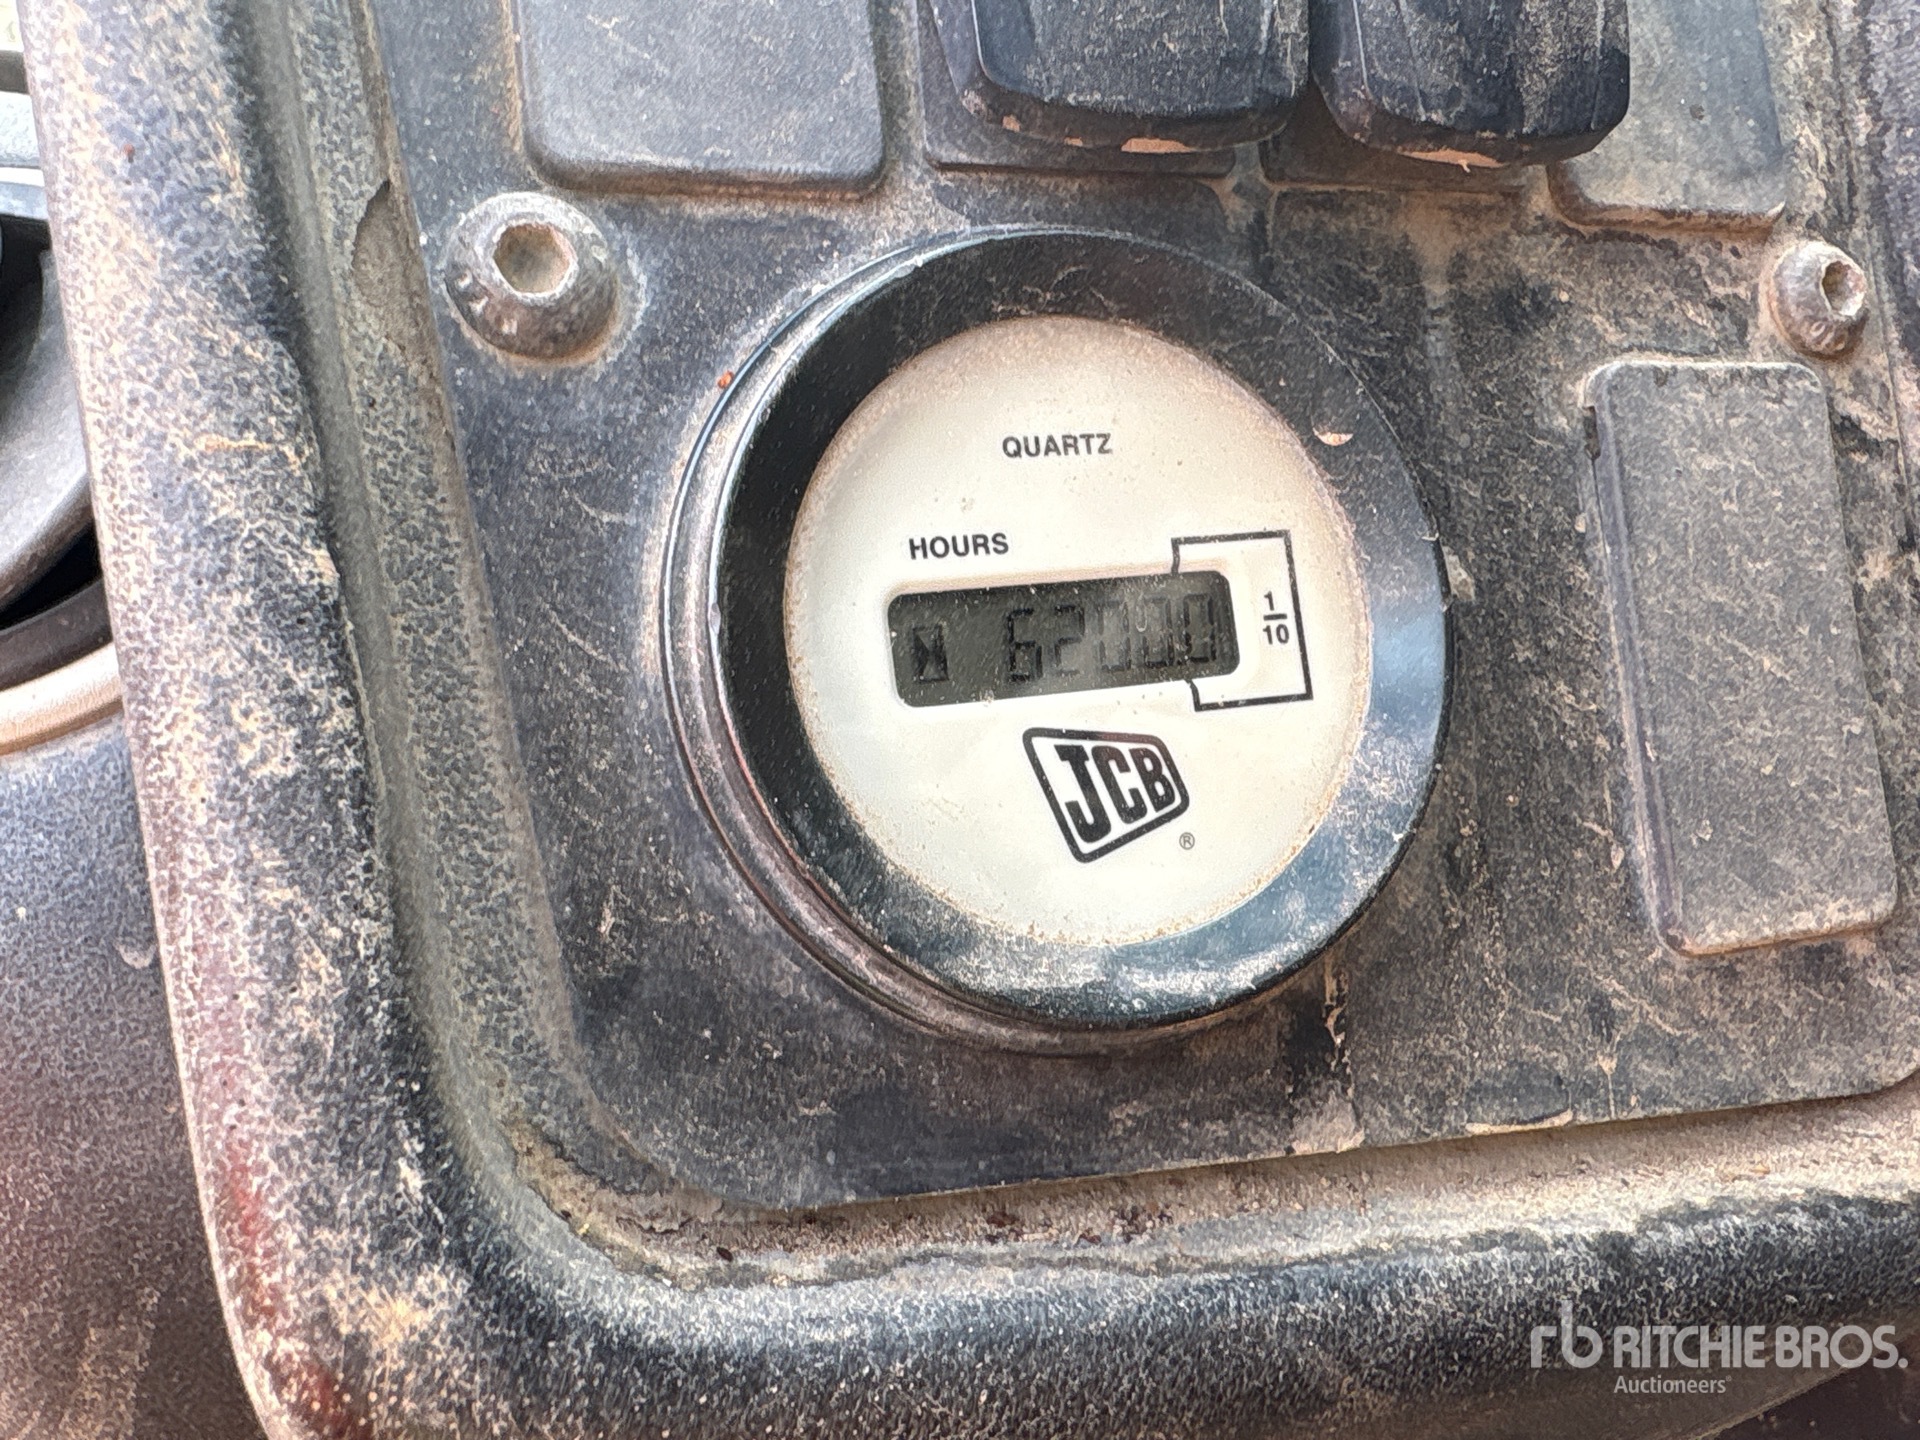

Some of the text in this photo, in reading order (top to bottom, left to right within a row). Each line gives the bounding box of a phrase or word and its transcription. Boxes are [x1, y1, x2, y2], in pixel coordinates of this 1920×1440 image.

[1002, 432, 1113, 459] QUARTZ
[908, 532, 1010, 560] HOURS
[1262, 623, 1290, 645] 10
[1053, 743, 1177, 844] JCB
